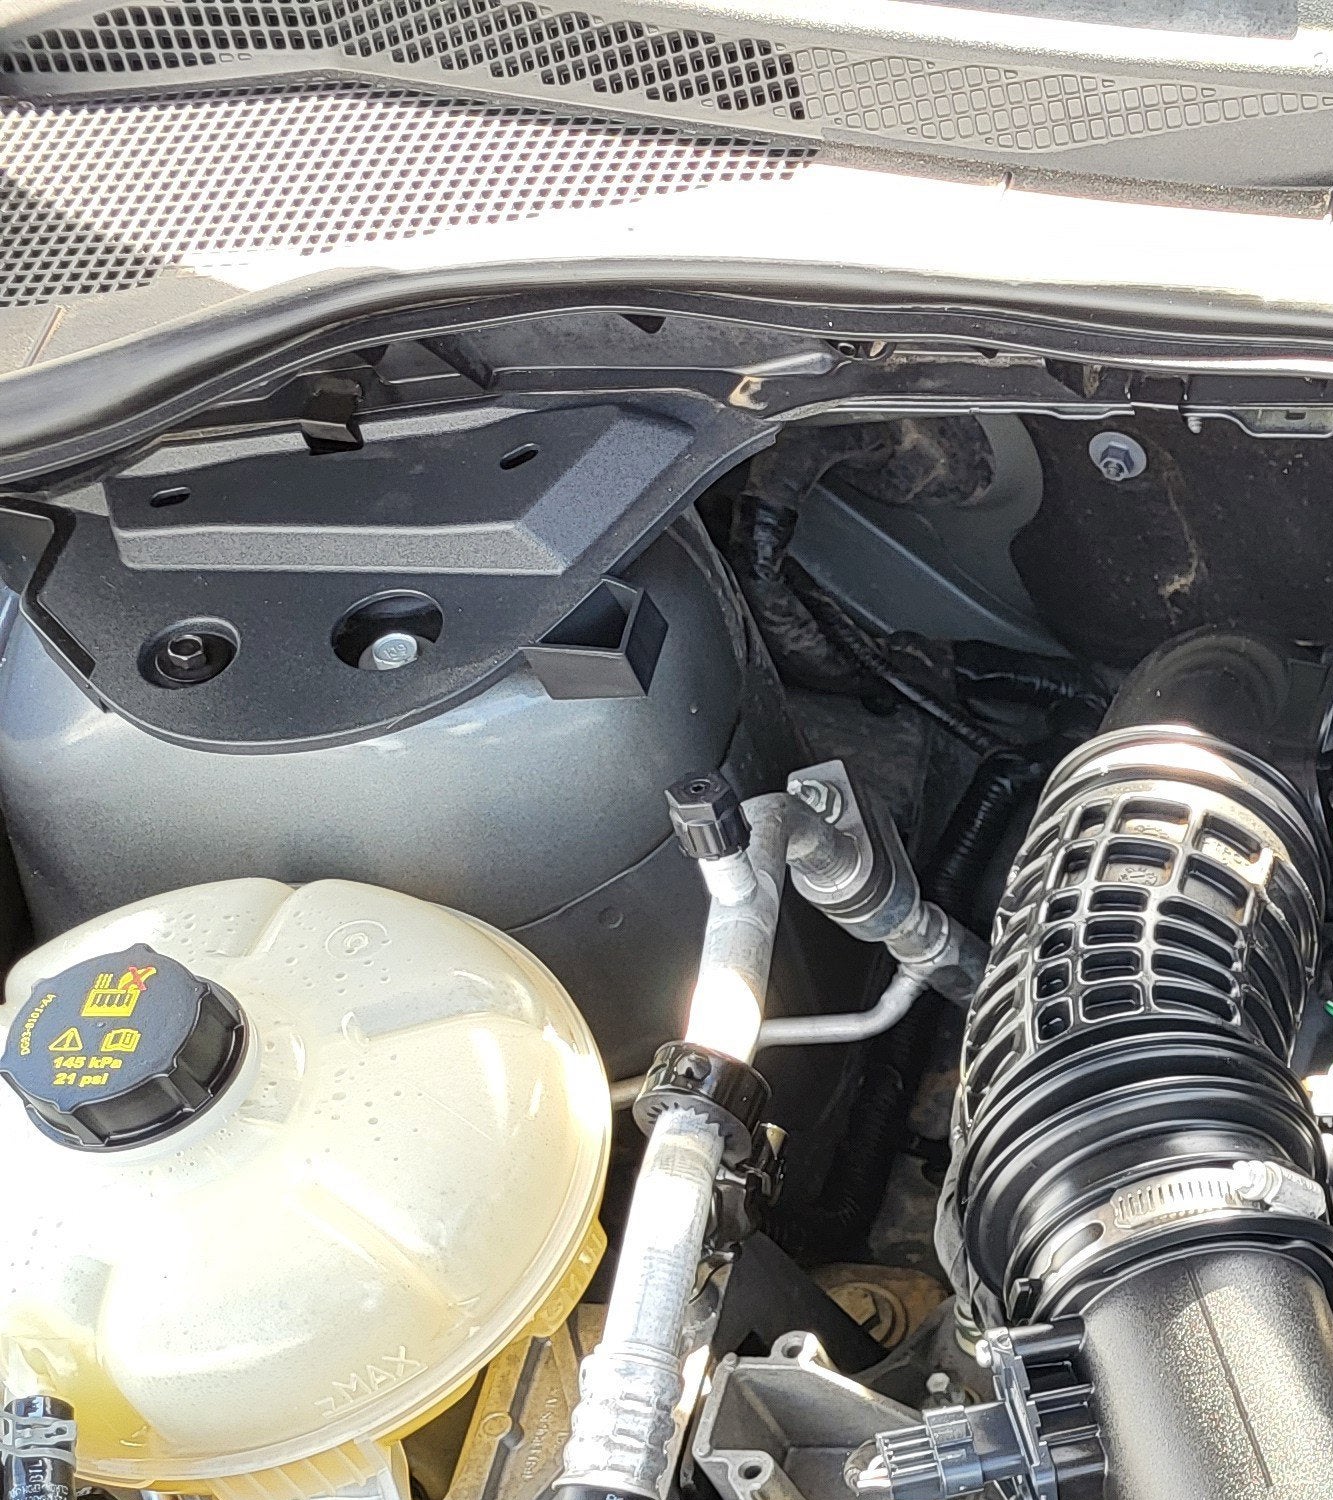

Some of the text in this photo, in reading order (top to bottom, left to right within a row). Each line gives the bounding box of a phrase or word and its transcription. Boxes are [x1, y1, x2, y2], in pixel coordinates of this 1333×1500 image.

[53, 1056, 123, 1069] 145 kPa
[53, 1073, 109, 1088] 21 psi
[331, 1346, 421, 1403] MAX
